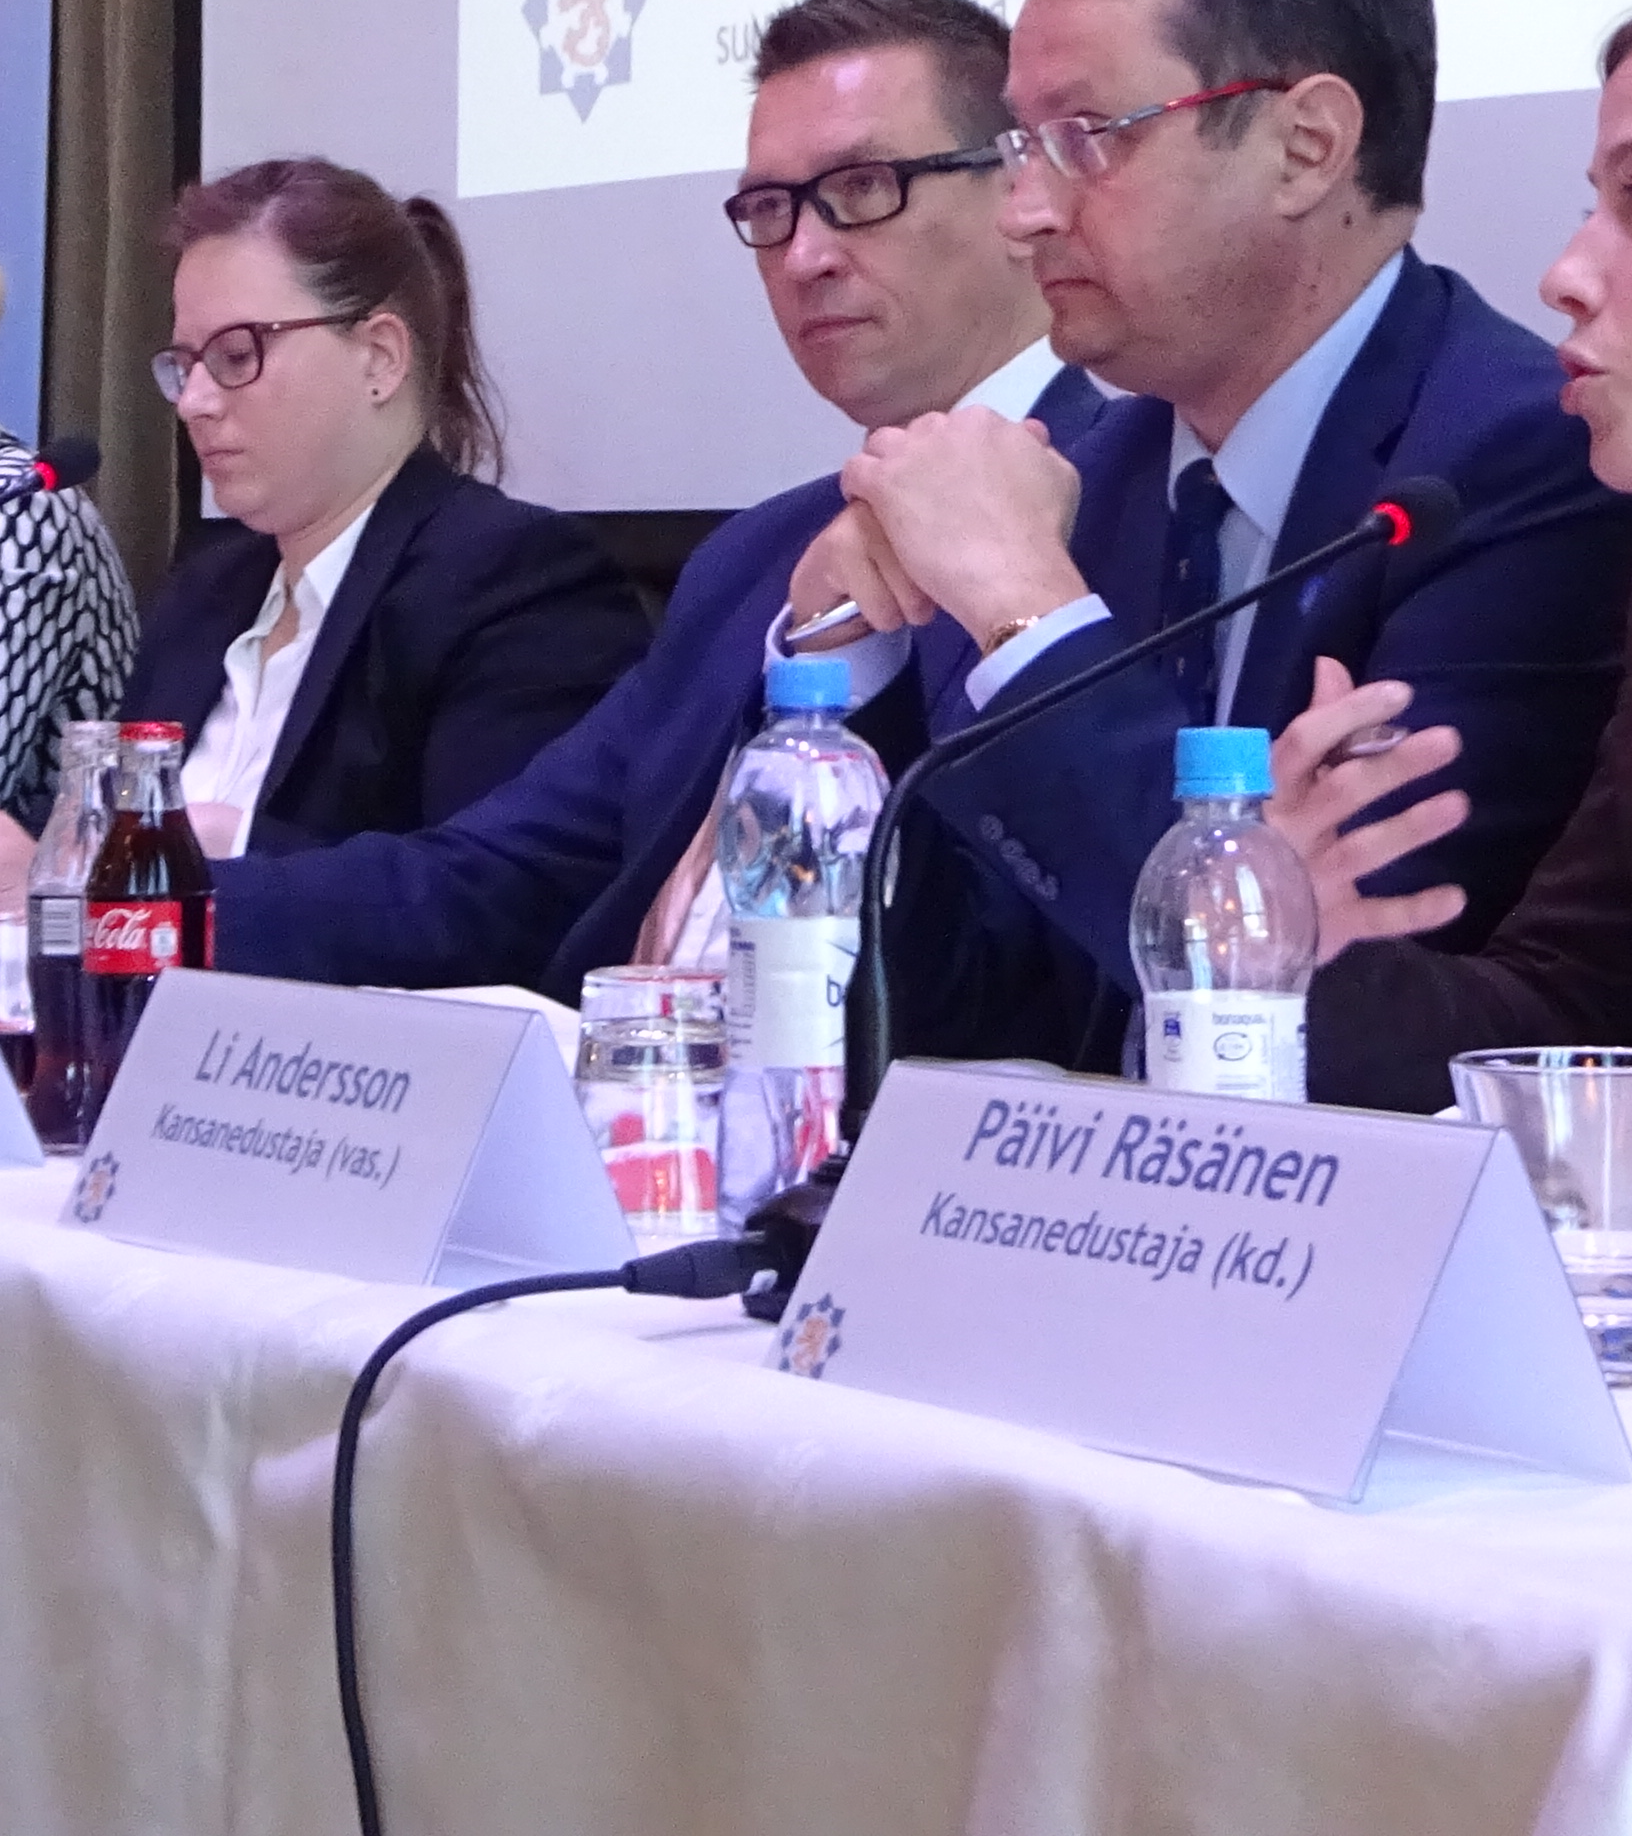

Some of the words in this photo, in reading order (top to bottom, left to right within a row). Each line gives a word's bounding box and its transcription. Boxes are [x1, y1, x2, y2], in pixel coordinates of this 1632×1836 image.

[192, 1029, 241, 1084] Li
[229, 1035, 413, 1114] Andersson
[150, 1102, 328, 1176] Kansanedustaja
[324, 1134, 402, 1191] (vas.)
[964, 1098, 1105, 1175] Päivi
[1100, 1112, 1340, 1207] Räsänen
[919, 1190, 1205, 1282] Kansanedustaja
[1210, 1231, 1316, 1301] (kd.)
